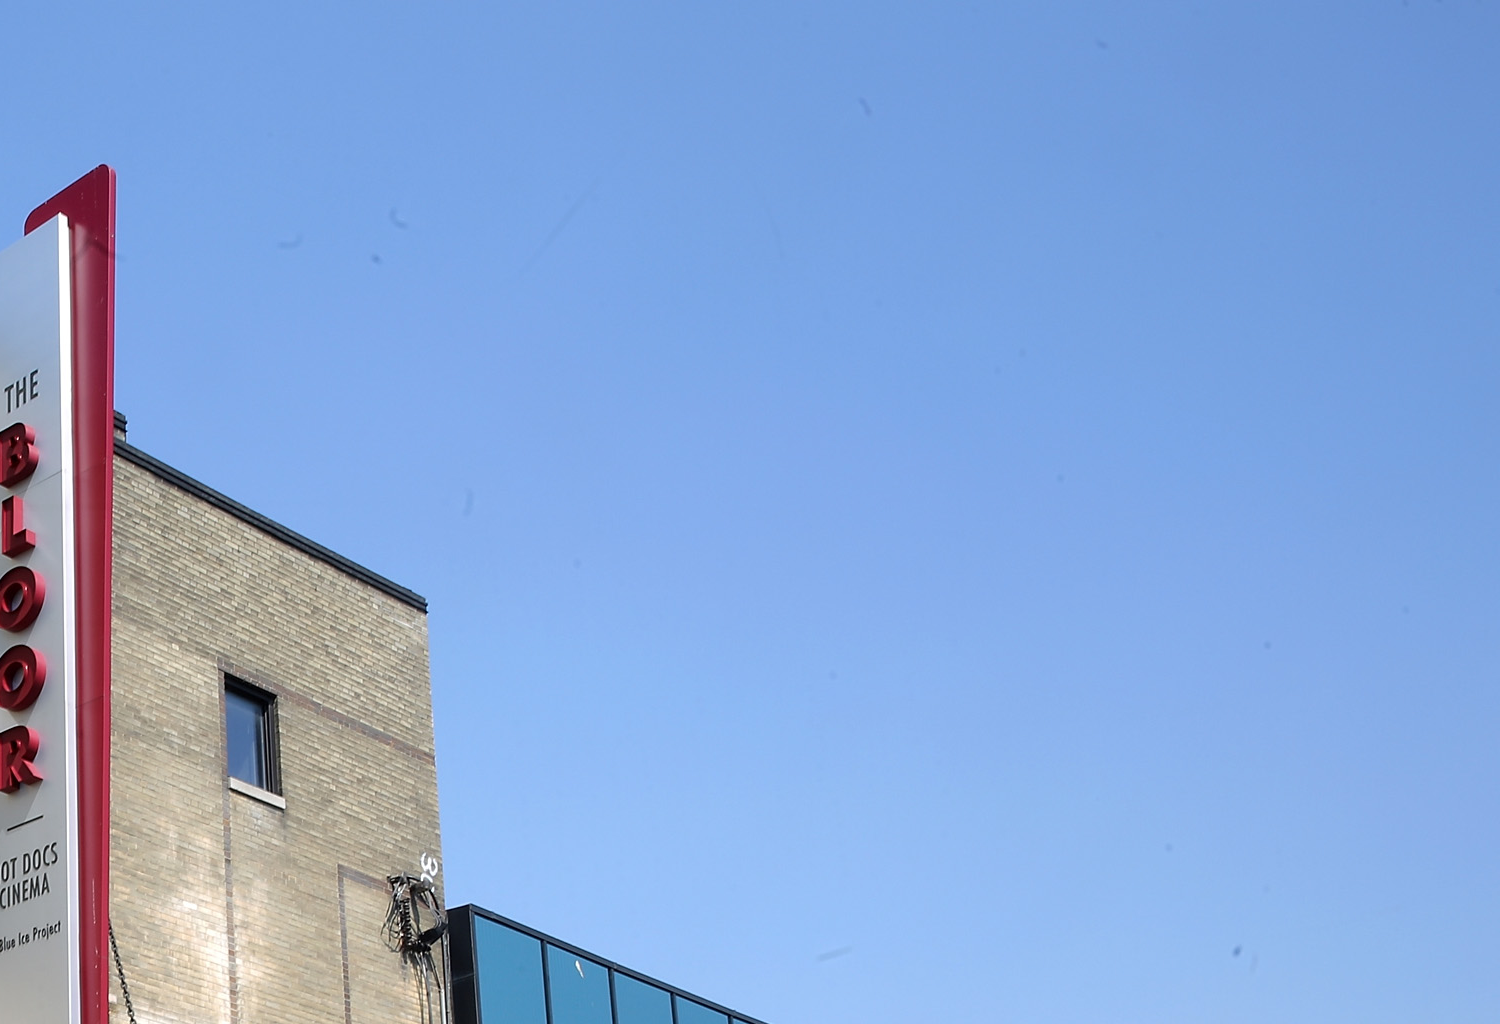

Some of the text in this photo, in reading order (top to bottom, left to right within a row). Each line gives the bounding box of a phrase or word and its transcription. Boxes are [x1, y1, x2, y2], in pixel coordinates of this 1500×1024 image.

[4, 369, 39, 414] THE
[23, 842, 58, 874] DOCS
[0, 872, 50, 909] CINEMA
[0, 936, 16, 953] Blue
[18, 932, 30, 946] Ice
[32, 920, 61, 941] Project
